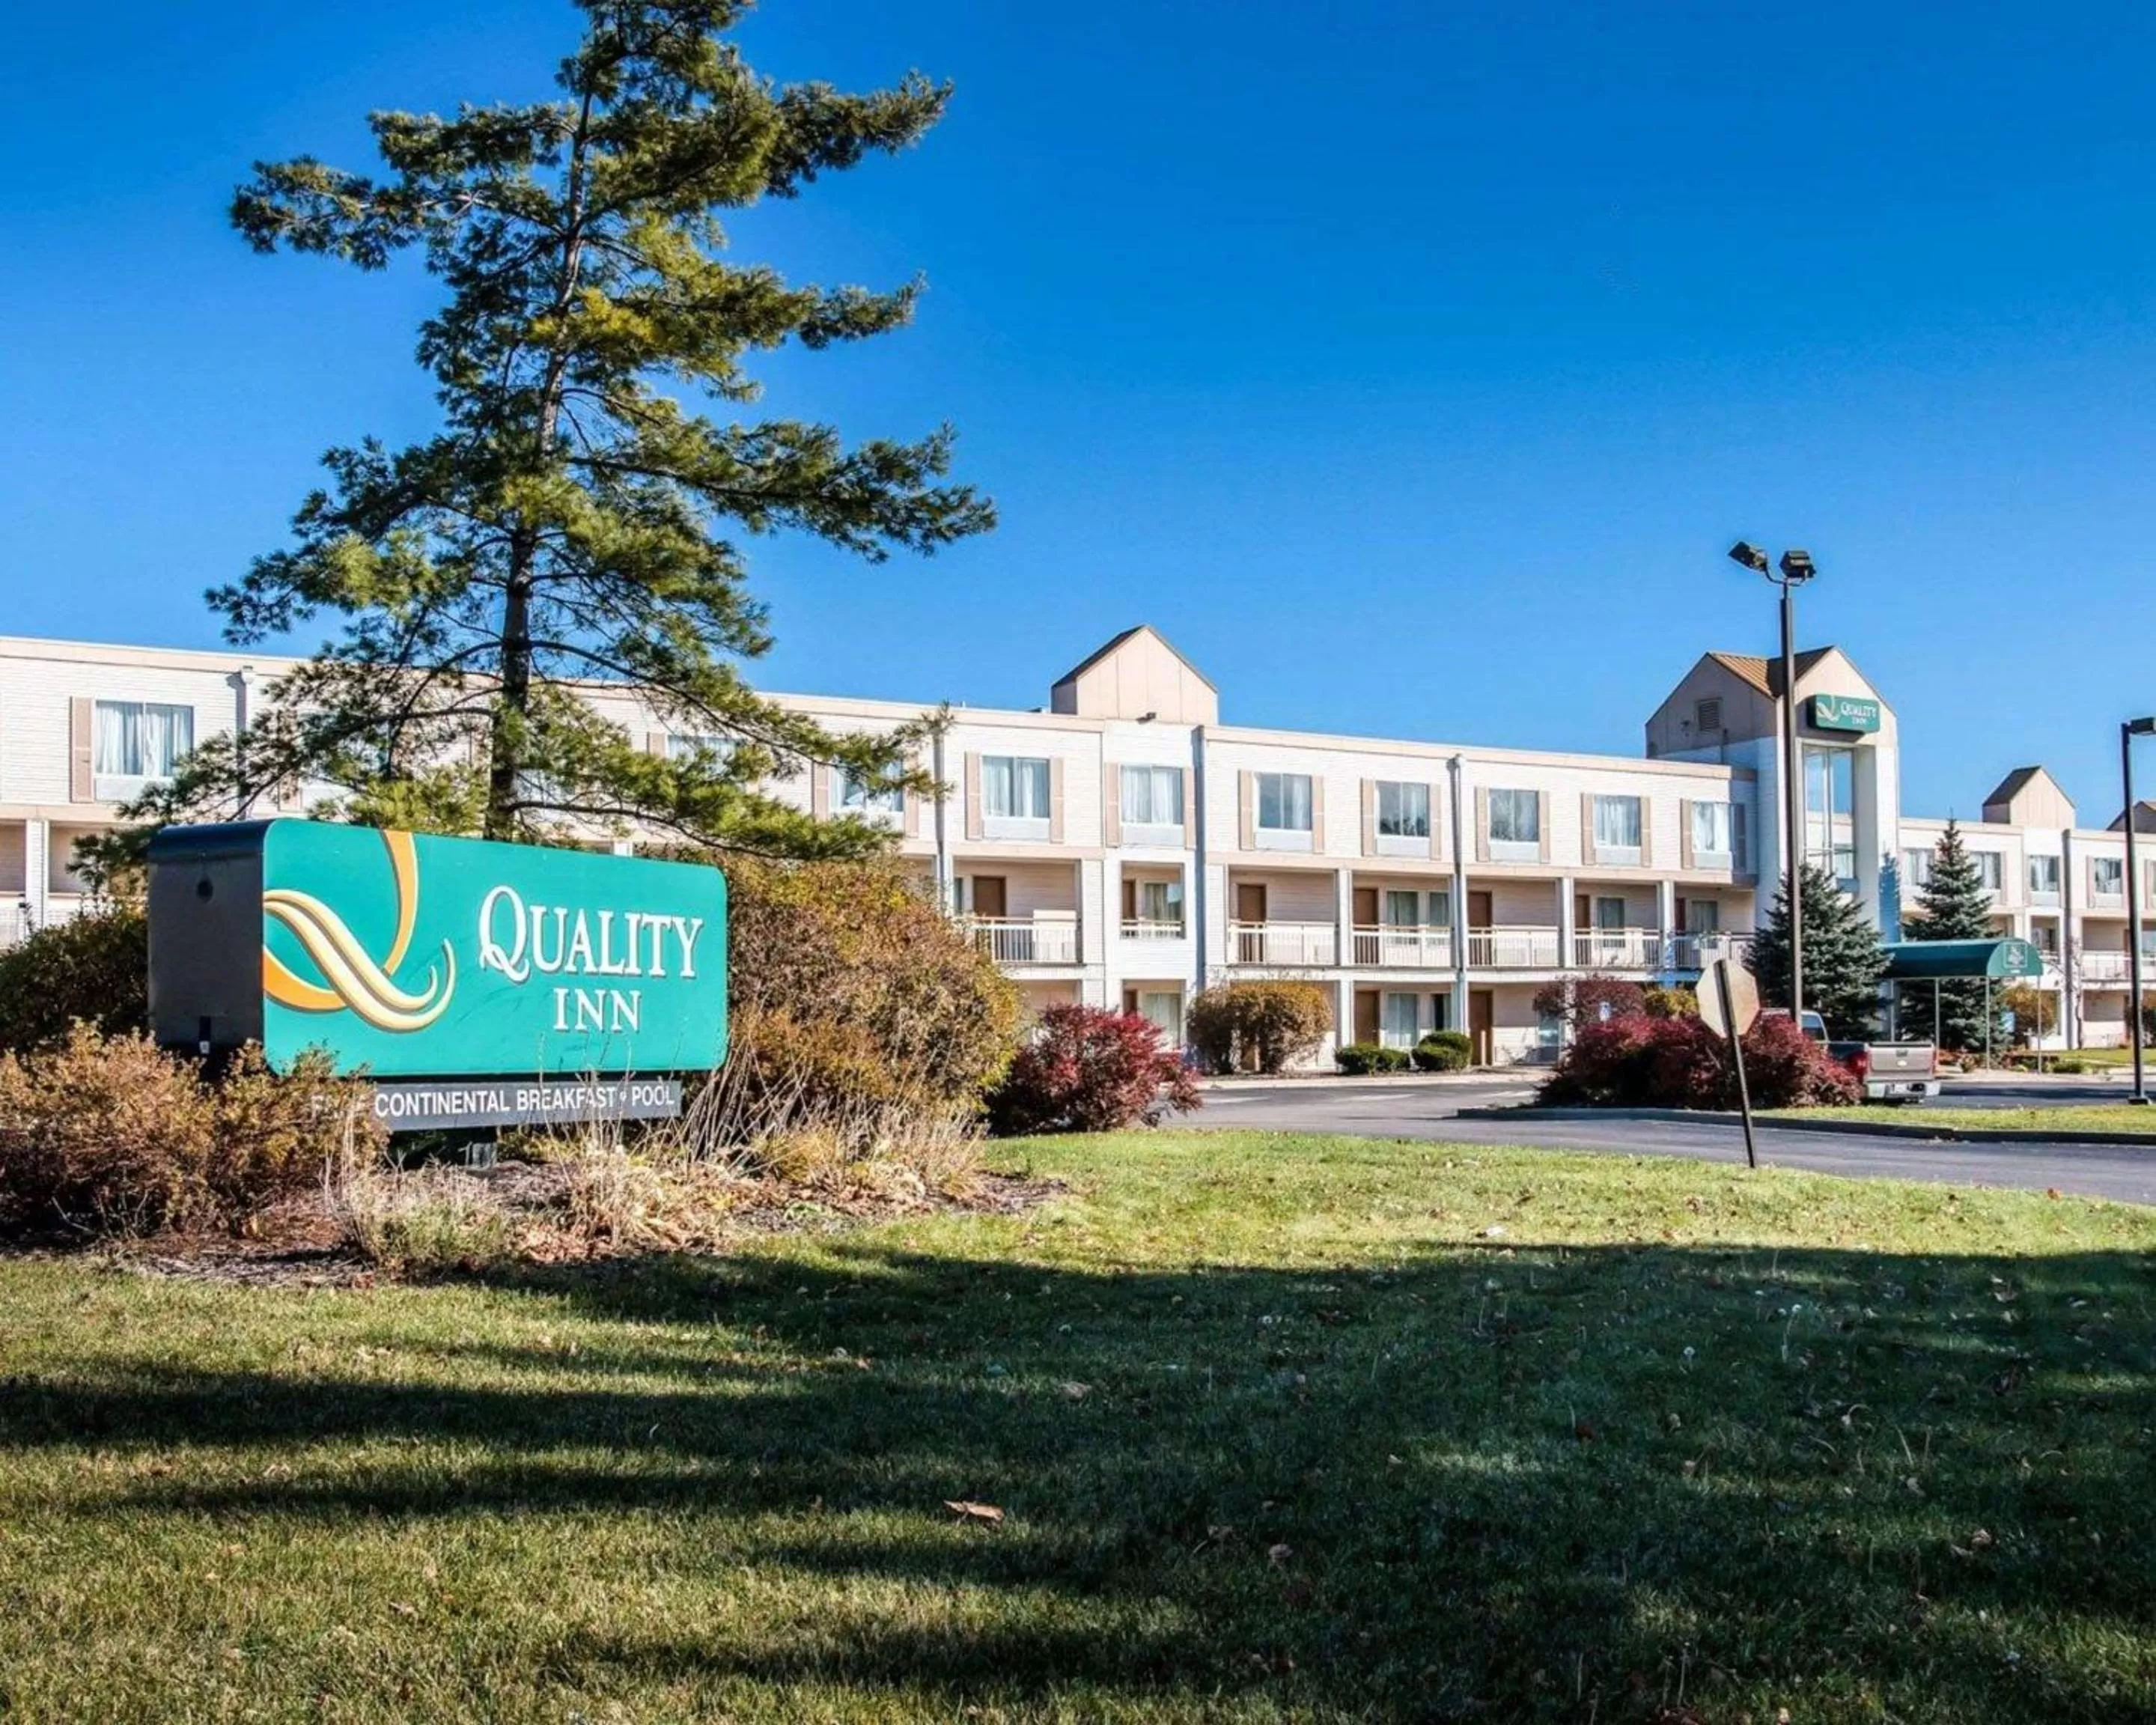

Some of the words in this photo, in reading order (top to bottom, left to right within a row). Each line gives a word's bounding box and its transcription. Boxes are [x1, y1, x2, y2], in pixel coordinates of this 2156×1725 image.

[478, 885, 704, 983] QUALITY
[553, 988, 642, 1033] INN
[374, 1090, 511, 1118] CONTINENTAL
[517, 1086, 618, 1112] BREAKFAST
[631, 1084, 674, 1107] POOL
